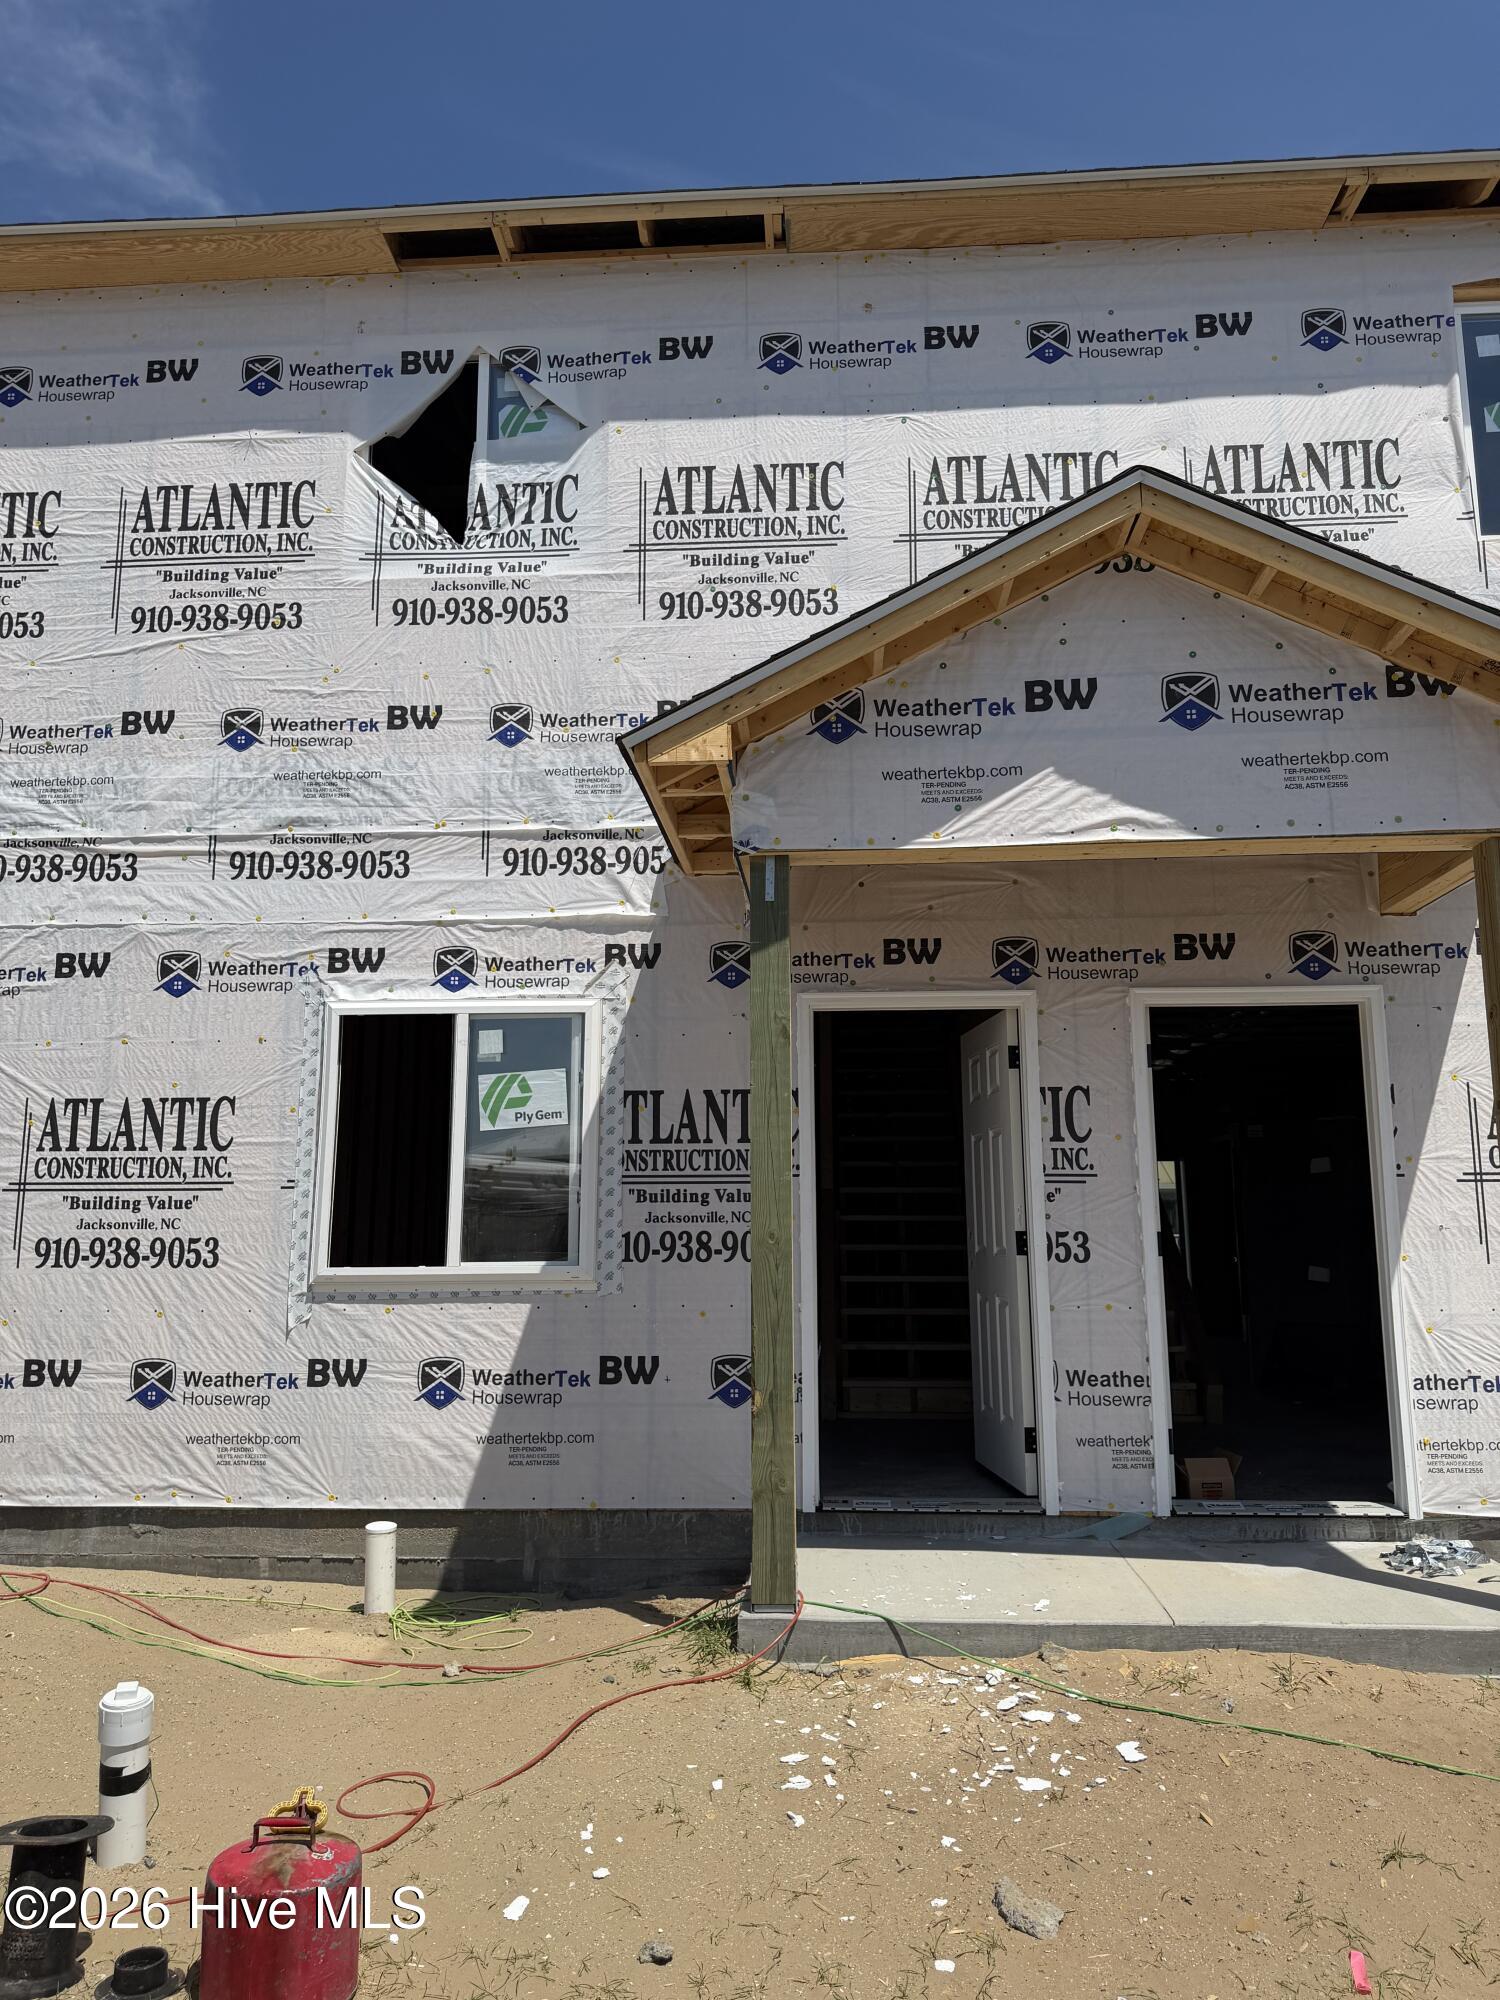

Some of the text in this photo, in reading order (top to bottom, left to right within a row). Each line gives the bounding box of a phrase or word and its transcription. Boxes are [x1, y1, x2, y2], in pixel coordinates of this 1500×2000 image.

[1195, 312, 1253, 338] BW
[1353, 314, 1455, 330] WeatherTe
[924, 326, 979, 350] BW
[1077, 328, 1189, 343] WeatherTek
[1355, 332, 1442, 345] Housewrap
[658, 336, 714, 361] BW
[808, 340, 917, 356] WeatherTek
[1079, 344, 1163, 358] Housewrap
[400, 349, 454, 375] BW
[547, 349, 652, 367] WeatherTek
[809, 354, 892, 370] Housewrap
[146, 358, 199, 383] BW
[289, 361, 393, 379] WeatherTek
[548, 366, 627, 384] Housewrap
[39, 373, 140, 388] WeatherTek
[289, 376, 368, 392] Housewrap
[38, 388, 114, 403] Housewrap
[1203, 437, 1401, 494] ATLANTIC
[653, 460, 844, 516] ATLANTIC
[131, 480, 316, 533] ATLANTIC
[1365, 493, 1405, 513] INC.
[923, 506, 1056, 530] CONSTRUCTI
[540, 526, 578, 547] INC.
[652, 514, 846, 541] CONSTRUCTION, INC.
[21, 541, 57, 561] INC.
[129, 532, 313, 557] CONSTRUCTION, INC.
[417, 560, 548, 576] "Building Value"
[682, 551, 815, 567] "Building Value"
[0, 576, 27, 588] lue"
[156, 567, 282, 583] "Building Value"
[698, 571, 800, 585] Jacksonville, NC
[169, 586, 267, 600] Jacksonville, NC
[431, 579, 531, 592] Jacksonville, NC
[392, 595, 569, 627] 910-938-9053
[659, 587, 839, 620] 910-938-9053
[131, 602, 303, 634] 910-938-9053
[1386, 665, 1457, 697] BW
[1025, 677, 1098, 712] BW
[1228, 682, 1378, 703] WeatherTek
[874, 697, 1015, 717] WeatherTek
[1232, 706, 1344, 723] Housewrap
[121, 710, 175, 736] BW
[270, 717, 379, 732] WeatherTek
[386, 705, 443, 730] BW
[540, 713, 650, 728] WeatherTek
[9, 724, 114, 739] WeatherTek
[874, 722, 982, 738] Housewrap
[9, 742, 88, 756] Housewrap
[270, 735, 353, 748] Housewrap
[1241, 751, 1389, 767] weathertekbp.com
[273, 770, 382, 782] weathertekbp.com
[544, 766, 634, 778] weathertekbp.c
[882, 765, 1023, 780] weathertekbp.com
[10, 776, 114, 788] weathertekbp.com
[3, 837, 102, 848] Jacksonville, NC
[270, 833, 372, 844] Jacksonville, NC
[543, 829, 644, 840] Jacksonville, NC
[0, 853, 138, 883] -938-9053
[229, 850, 410, 880] 910-938-9053
[503, 845, 665, 877] 910-938-905
[605, 943, 661, 969] BW
[883, 938, 942, 965] BW
[1173, 933, 1236, 961] BW
[1344, 940, 1469, 959] WeatherTek
[55, 952, 111, 978] BW
[328, 947, 385, 974] BW
[485, 956, 596, 973] WeatherTek
[791, 952, 876, 969] atherTek
[1046, 948, 1166, 965] WeatherTek
[1048, 966, 1139, 982] Housewrap
[1348, 960, 1440, 976] Housewrap
[208, 980, 293, 994] Housewrap
[485, 975, 570, 989] Housewrap
[791, 972, 849, 985] sewrap
[36, 1096, 236, 1152] ATLANTIC
[514, 1110, 562, 1124] Ply Gem
[624, 1088, 751, 1145] TLANT
[622, 1149, 751, 1172] NSTRUCTION
[1051, 1147, 1094, 1171] INC.
[34, 1156, 232, 1184] CONSTRUCTION, INC.
[62, 1195, 199, 1213] "Building Value"
[629, 1189, 751, 1206] "Building Valu
[76, 1218, 181, 1231] Jacksonville, NC
[645, 1211, 751, 1224] Jacksonville, NC
[34, 1236, 220, 1269] 910-938-9053
[23, 1359, 82, 1387] BW
[307, 1359, 368, 1388] BW
[472, 1368, 591, 1388] WeatherTek
[599, 1355, 660, 1385] BW
[1065, 1369, 1151, 1388] Weathe
[183, 1371, 299, 1390] WeatherTek
[1413, 1373, 1500, 1393] atherTe
[182, 1391, 271, 1409] Housewrap
[472, 1389, 562, 1408] Housewrap
[1068, 1390, 1152, 1407] Housewra
[1413, 1398, 1478, 1414] sewrap
[186, 1433, 301, 1447] weathertekbp.com
[476, 1432, 594, 1446] weathertekbp.com
[1076, 1434, 1153, 1448] weathertek
